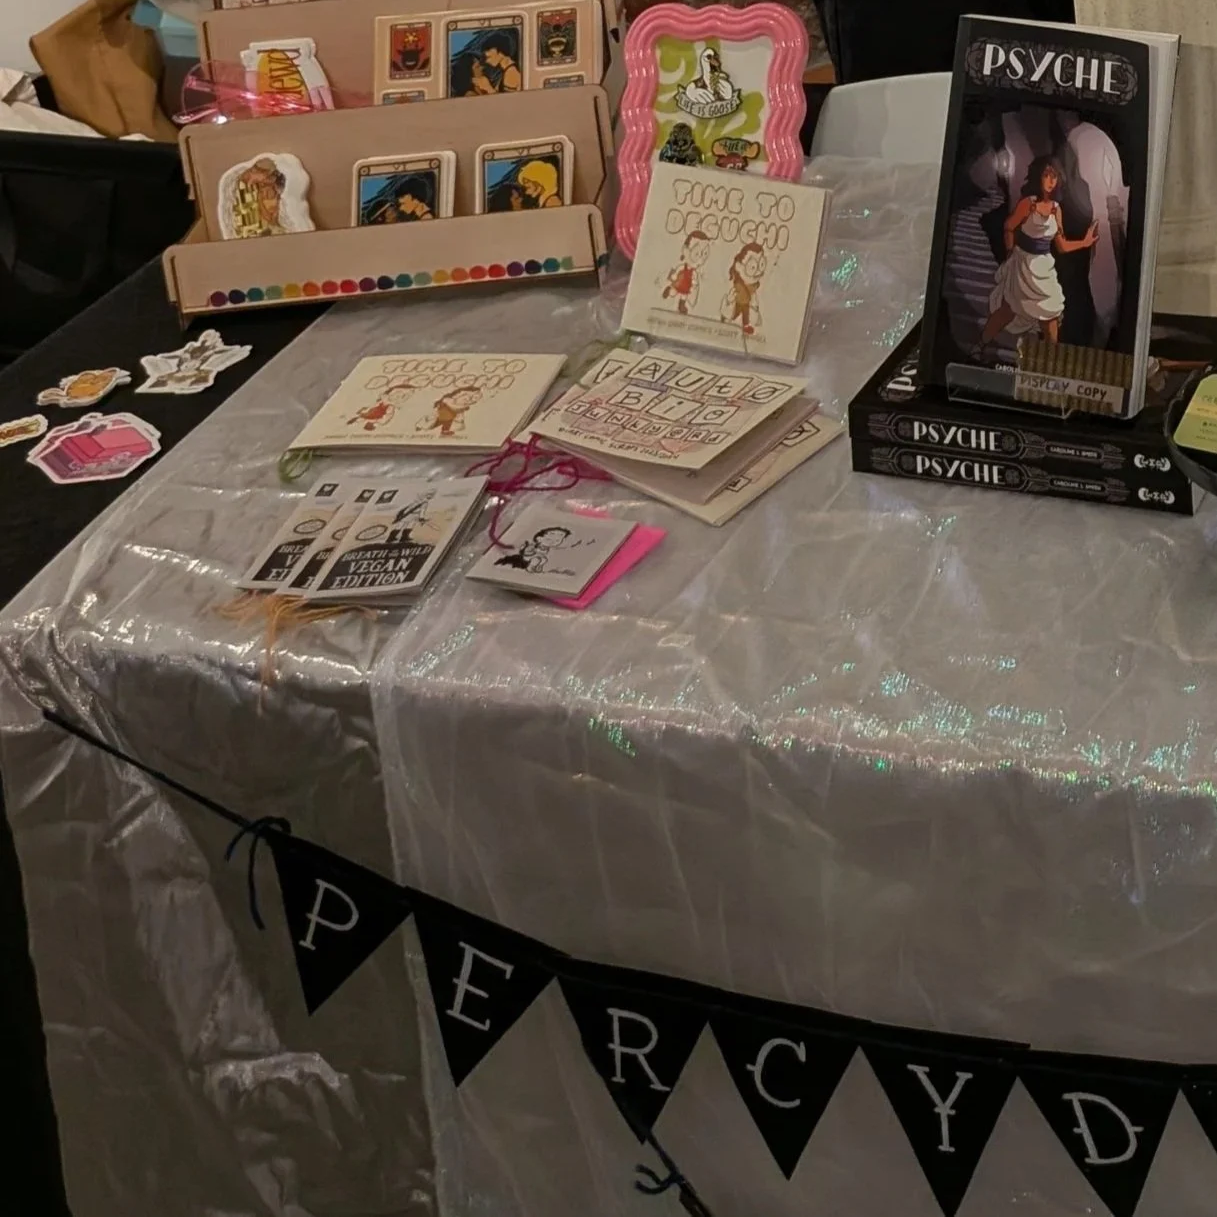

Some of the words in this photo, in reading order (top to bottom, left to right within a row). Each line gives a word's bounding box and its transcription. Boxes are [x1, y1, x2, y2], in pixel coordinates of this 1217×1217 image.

[984, 43, 1122, 95] PSYCHE
[672, 178, 745, 215] TIME
[756, 191, 796, 222] TO
[665, 207, 790, 252] DEGUCHI
[383, 358, 469, 374] TIME
[482, 358, 527, 374] TO
[364, 374, 516, 390] DEGUCHI
[1021, 374, 1070, 393] DISPLAY
[1076, 384, 1107, 399] COPY
[913, 421, 1001, 451] PSYCHE
[916, 454, 1005, 484] PSYCHE
[341, 549, 388, 562] BREATH
[400, 545, 431, 556] WILD
[348, 557, 413, 574] VEGAN
[328, 571, 408, 589] EDITION
